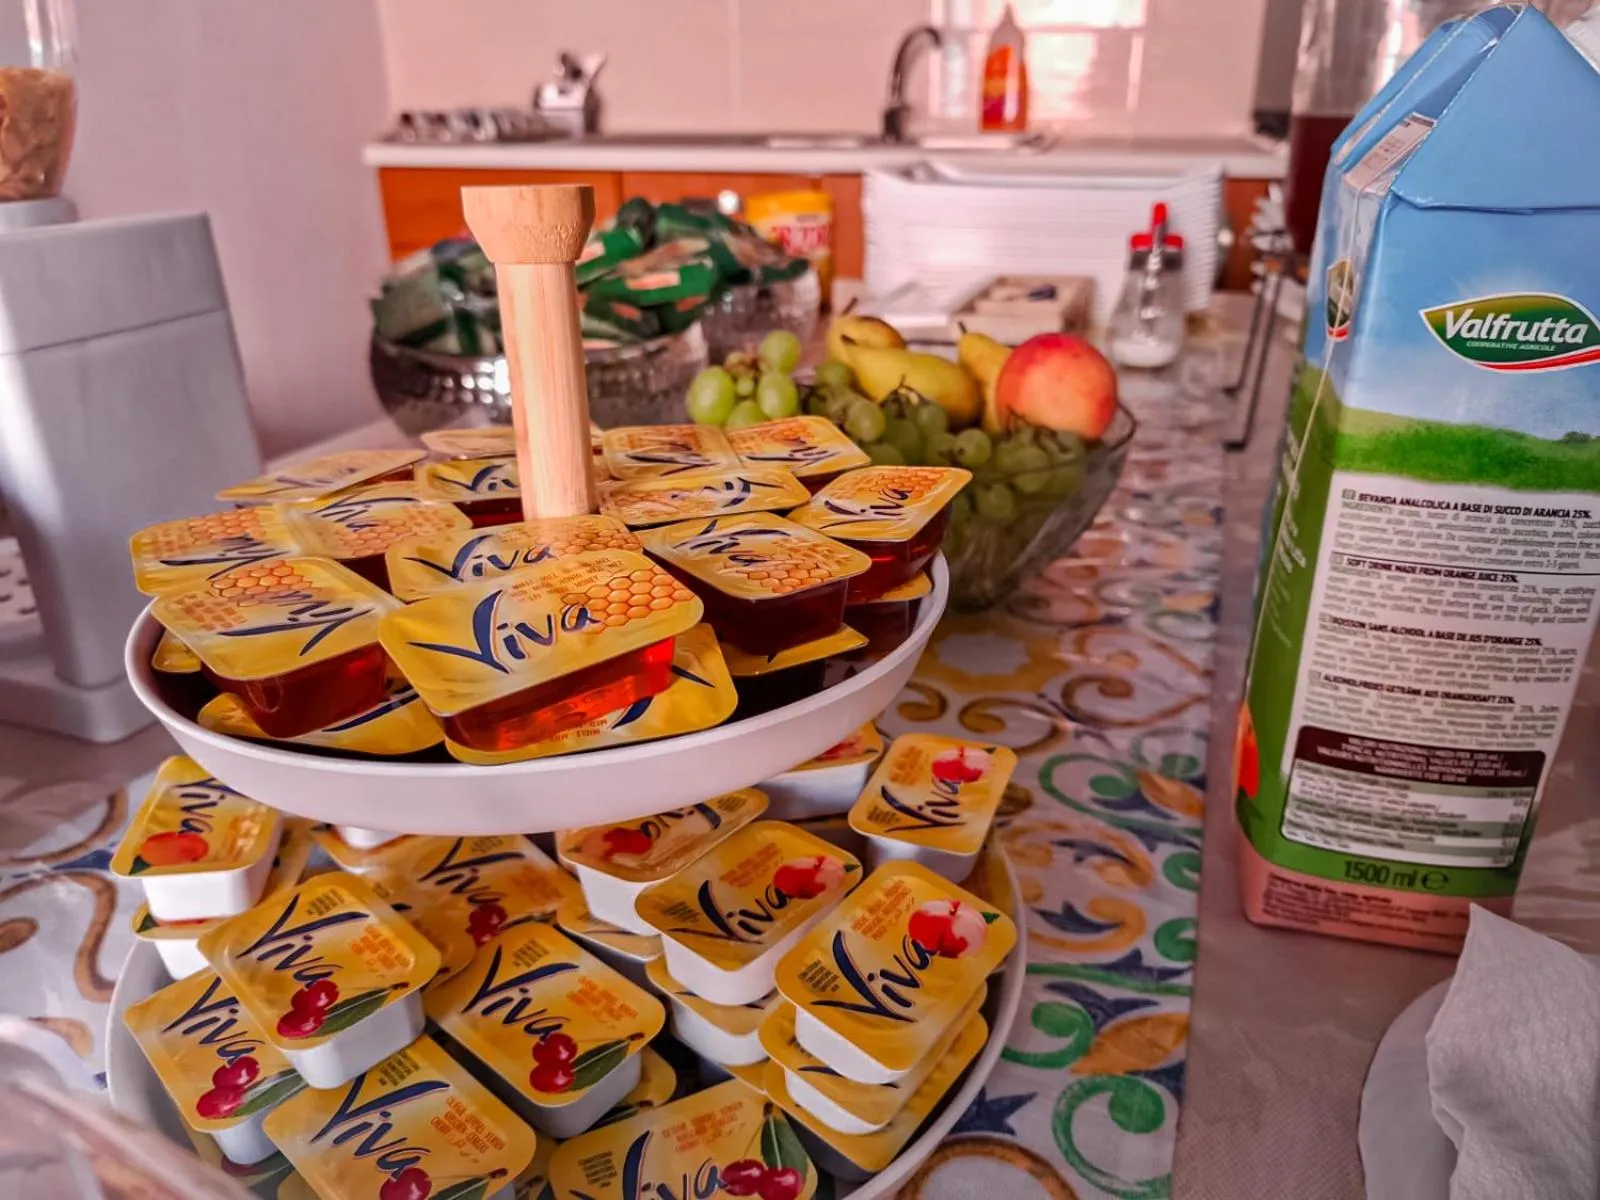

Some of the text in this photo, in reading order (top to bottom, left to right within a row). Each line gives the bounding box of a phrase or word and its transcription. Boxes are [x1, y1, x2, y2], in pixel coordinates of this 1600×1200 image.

[1444, 308, 1590, 344] Valfrutta
[1466, 340, 1518, 350] COOPERATIVE
[819, 487, 912, 529] Viva
[1358, 493, 1397, 505] BEVANDA
[1399, 498, 1451, 510] ANALCOLICA
[1452, 502, 1459, 510] A
[1460, 502, 1481, 512] BASE
[1483, 505, 1493, 514] DI
[1494, 505, 1521, 516] SUCCO
[1522, 507, 1533, 516] DI
[1533, 508, 1570, 518] ARANCIA
[159, 533, 292, 581] Viva
[402, 534, 556, 582] Viva
[672, 518, 793, 567] Viva
[1346, 558, 1367, 568] SOFT
[1395, 564, 1418, 574] MADE
[1419, 567, 1442, 577] FROM
[1443, 569, 1476, 580] ORANGE
[216, 588, 376, 657] Viva
[406, 589, 602, 674] Viva
[1435, 631, 1456, 640] BASE
[1457, 633, 1467, 641] DE
[881, 778, 967, 832] Viva
[417, 836, 525, 905] Viva
[1344, 860, 1418, 887] 1500 ml
[668, 880, 792, 944] Viva
[236, 893, 370, 988] Viva
[462, 944, 580, 1041] Viva
[810, 929, 939, 1023] Viva
[162, 976, 264, 1066] Viva
[310, 1070, 451, 1181] Viva
